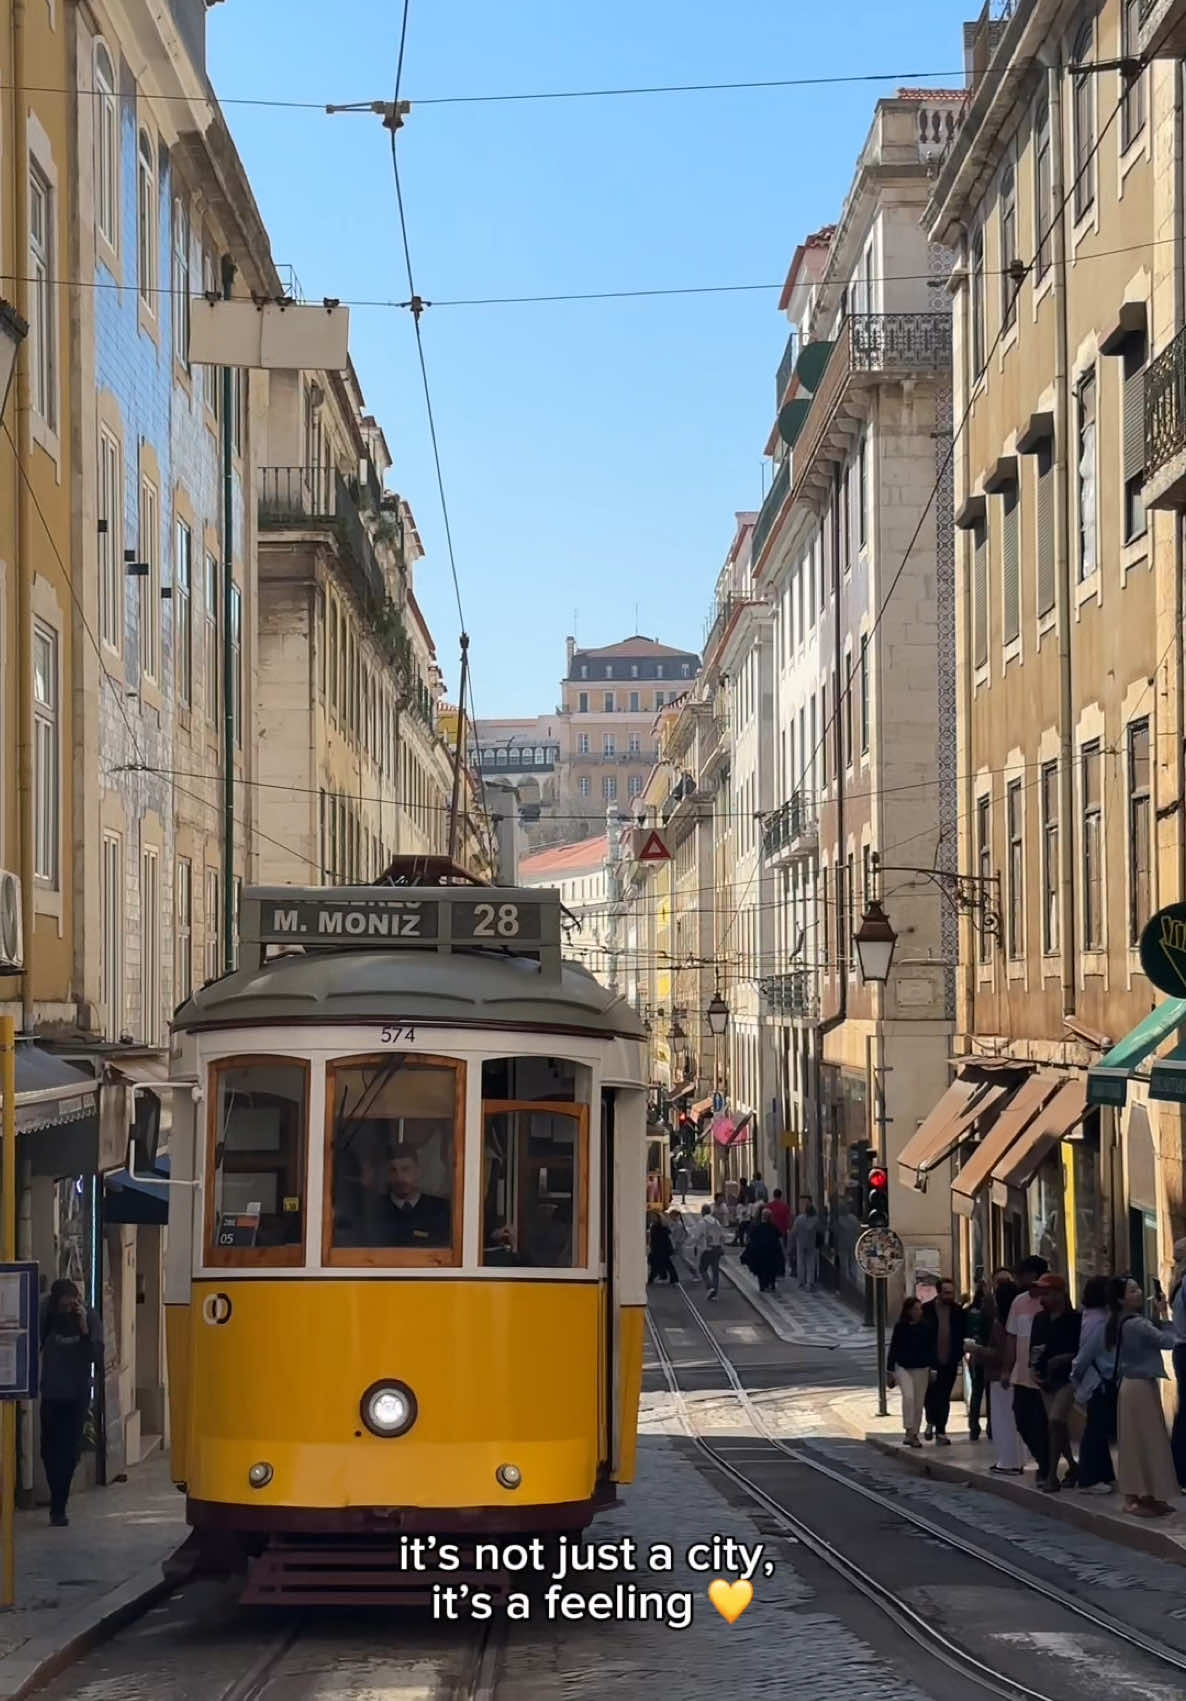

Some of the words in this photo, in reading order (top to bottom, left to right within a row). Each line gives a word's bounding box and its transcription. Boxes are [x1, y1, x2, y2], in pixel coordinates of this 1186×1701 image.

[273, 910, 307, 932] M.
[318, 911, 421, 936] MONIZ
[473, 904, 520, 936] 28
[380, 1026, 416, 1043] 574
